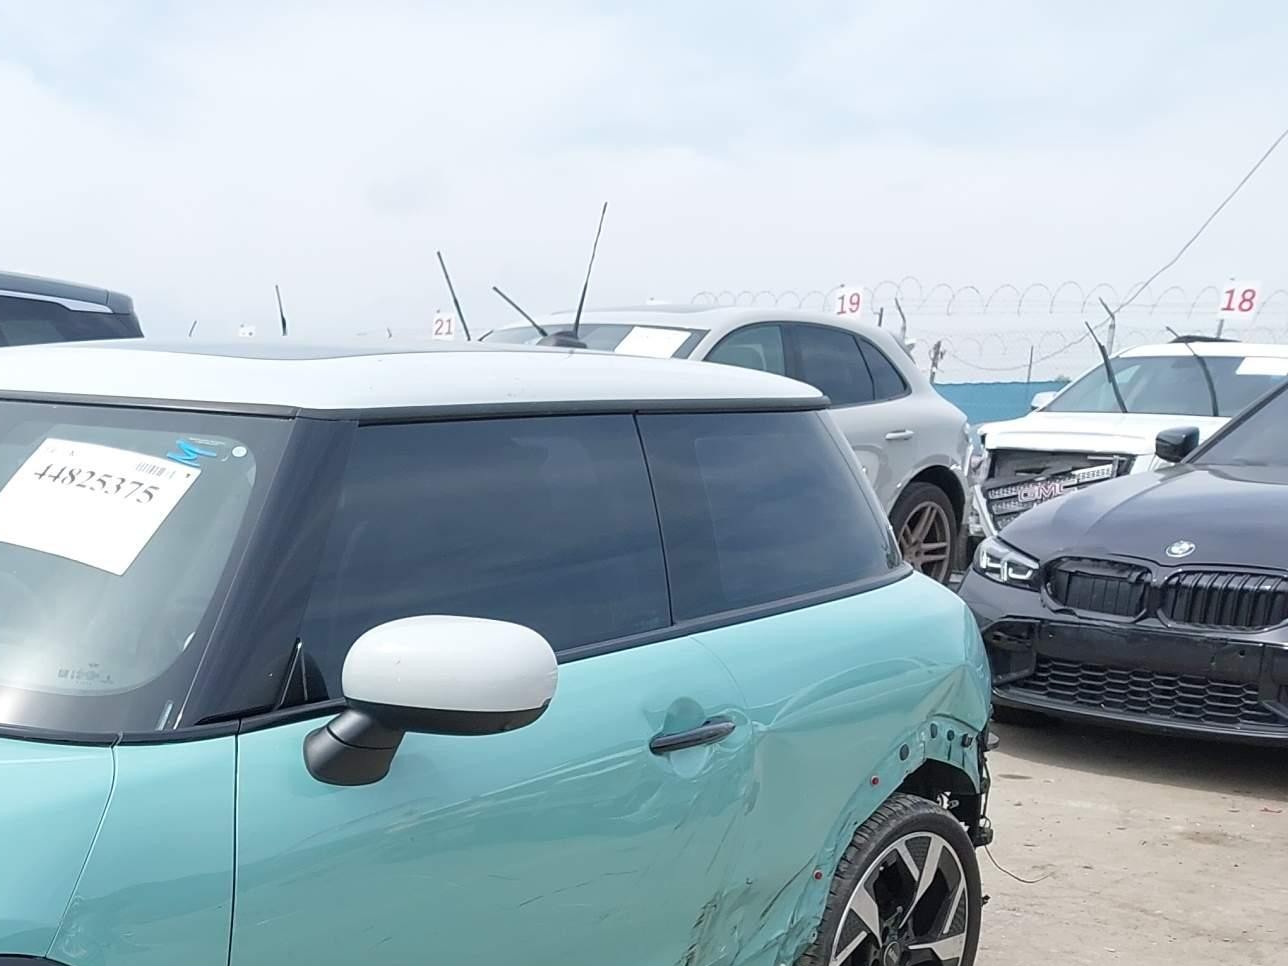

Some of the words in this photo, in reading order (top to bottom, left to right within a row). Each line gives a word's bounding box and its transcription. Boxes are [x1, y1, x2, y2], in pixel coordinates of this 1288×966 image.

[836, 292, 861, 315] 19
[1220, 288, 1257, 312] 18
[434, 318, 453, 336] 21
[33, 463, 161, 504] 44825375
[1018, 481, 1076, 502] GMC
